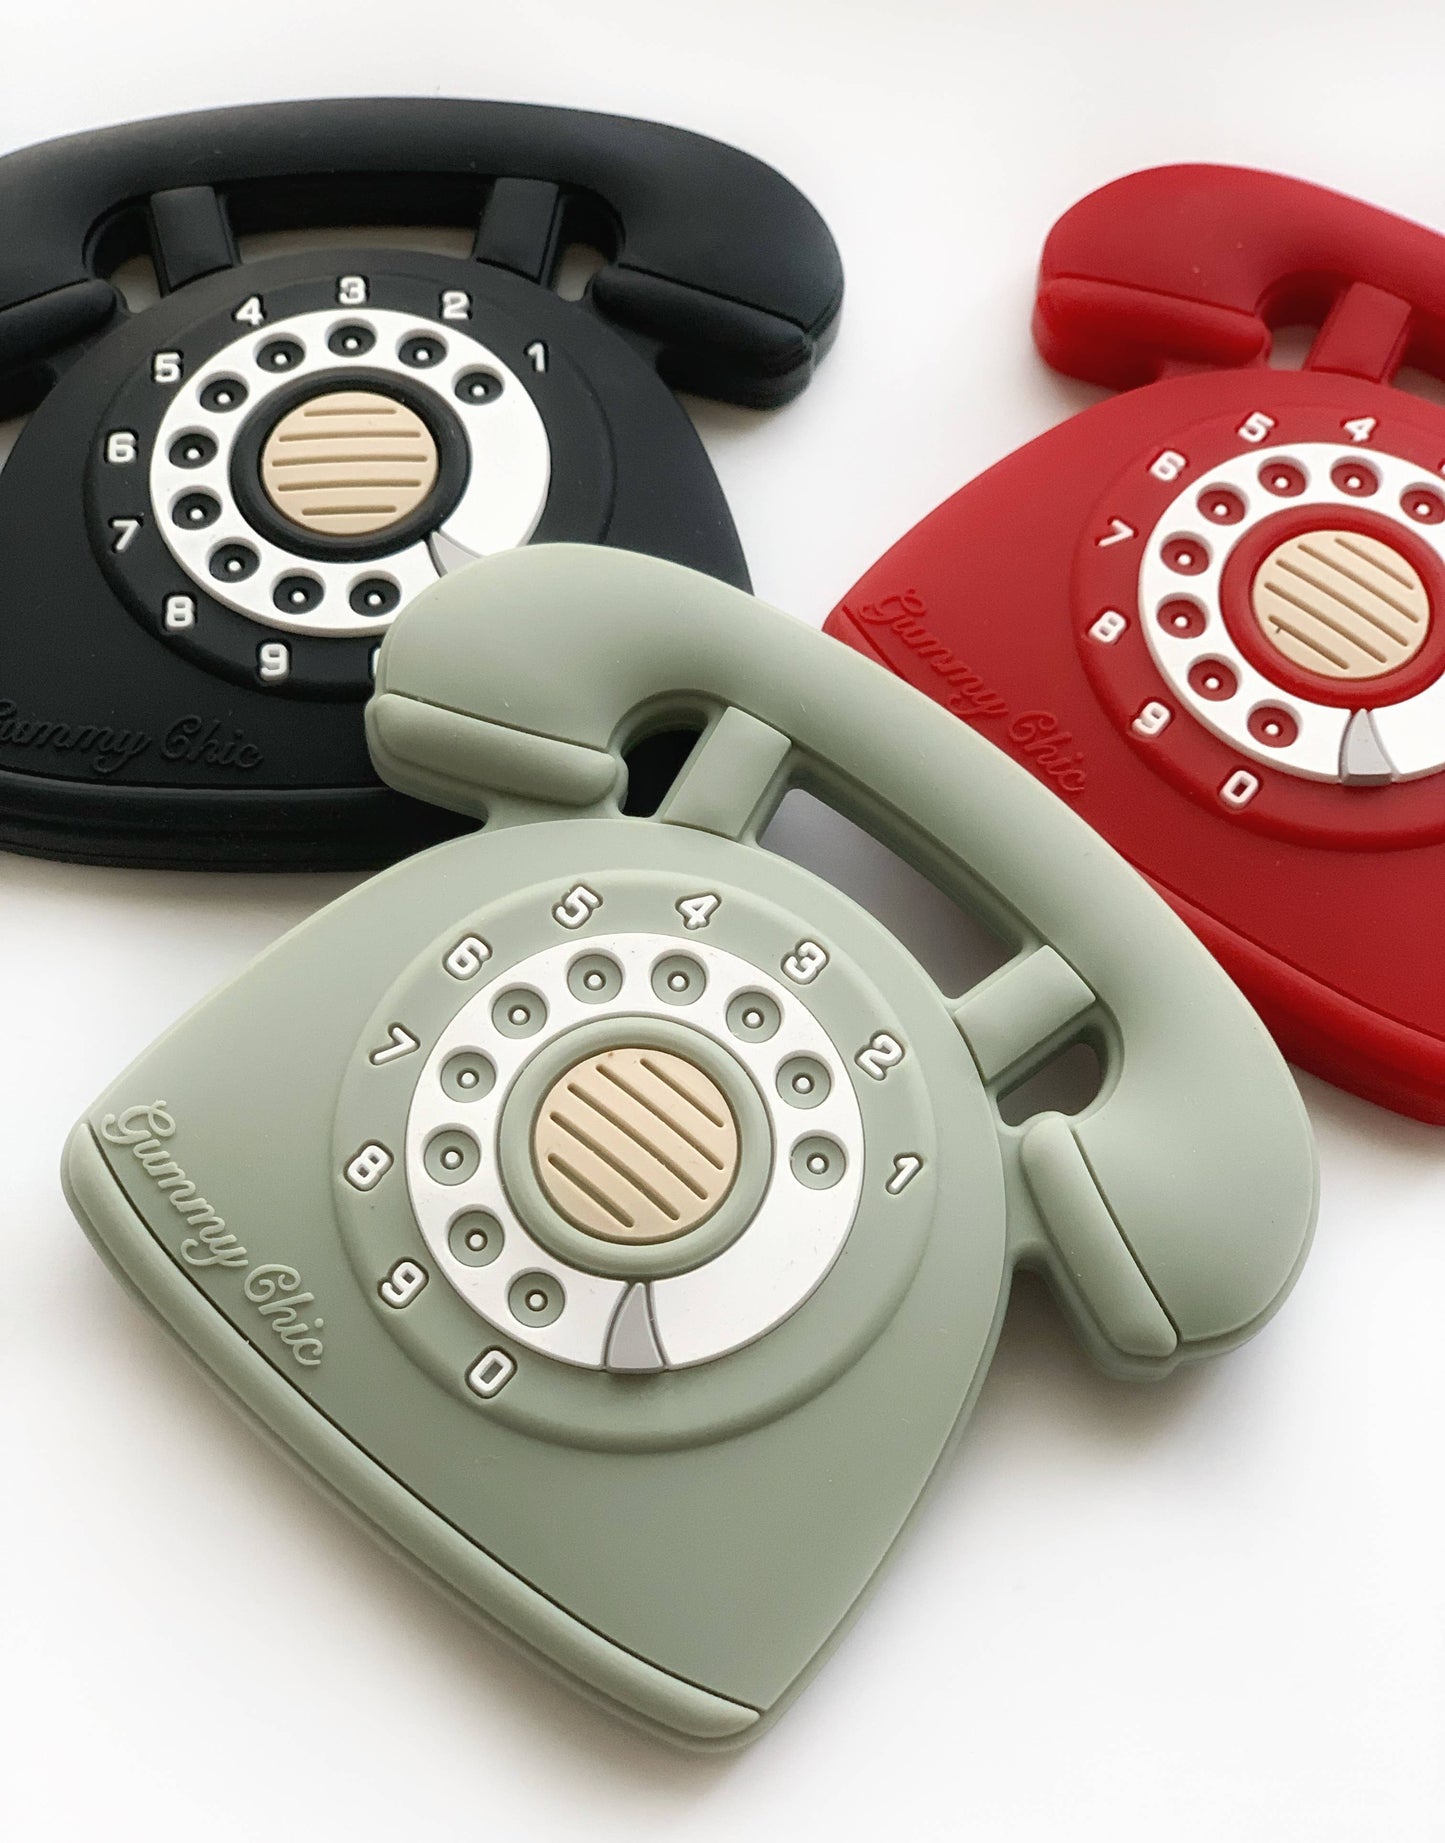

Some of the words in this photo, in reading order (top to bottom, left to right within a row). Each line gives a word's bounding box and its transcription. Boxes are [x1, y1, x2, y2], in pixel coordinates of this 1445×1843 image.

[338, 275, 367, 307] 3
[441, 290, 470, 322] 2
[235, 297, 263, 325] 4
[153, 352, 181, 384] 5
[527, 342, 546, 373] 1
[1238, 411, 1275, 444] 5
[1343, 417, 1377, 443] 4
[107, 431, 137, 464] 6
[1149, 450, 1187, 483] 6
[112, 519, 143, 553] 7
[1098, 519, 1135, 548] 7
[165, 595, 195, 630] 8
[1089, 610, 1126, 644] 8
[259, 642, 290, 679] 9
[859, 588, 1009, 721] Gummy
[1008, 709, 1087, 792] Chic
[1132, 701, 1171, 736] 9
[161, 714, 264, 768] Chic
[555, 886, 601, 927] 5
[680, 894, 719, 927] 4
[445, 936, 489, 979] 6
[784, 942, 827, 982] 3
[372, 1027, 418, 1064] 7
[858, 1034, 903, 1078] 2
[347, 1145, 391, 1189] 8
[887, 1156, 921, 1193] 1
[101, 1099, 249, 1268] Gummy
[243, 1263, 324, 1366] Chic
[380, 1262, 427, 1306] 9
